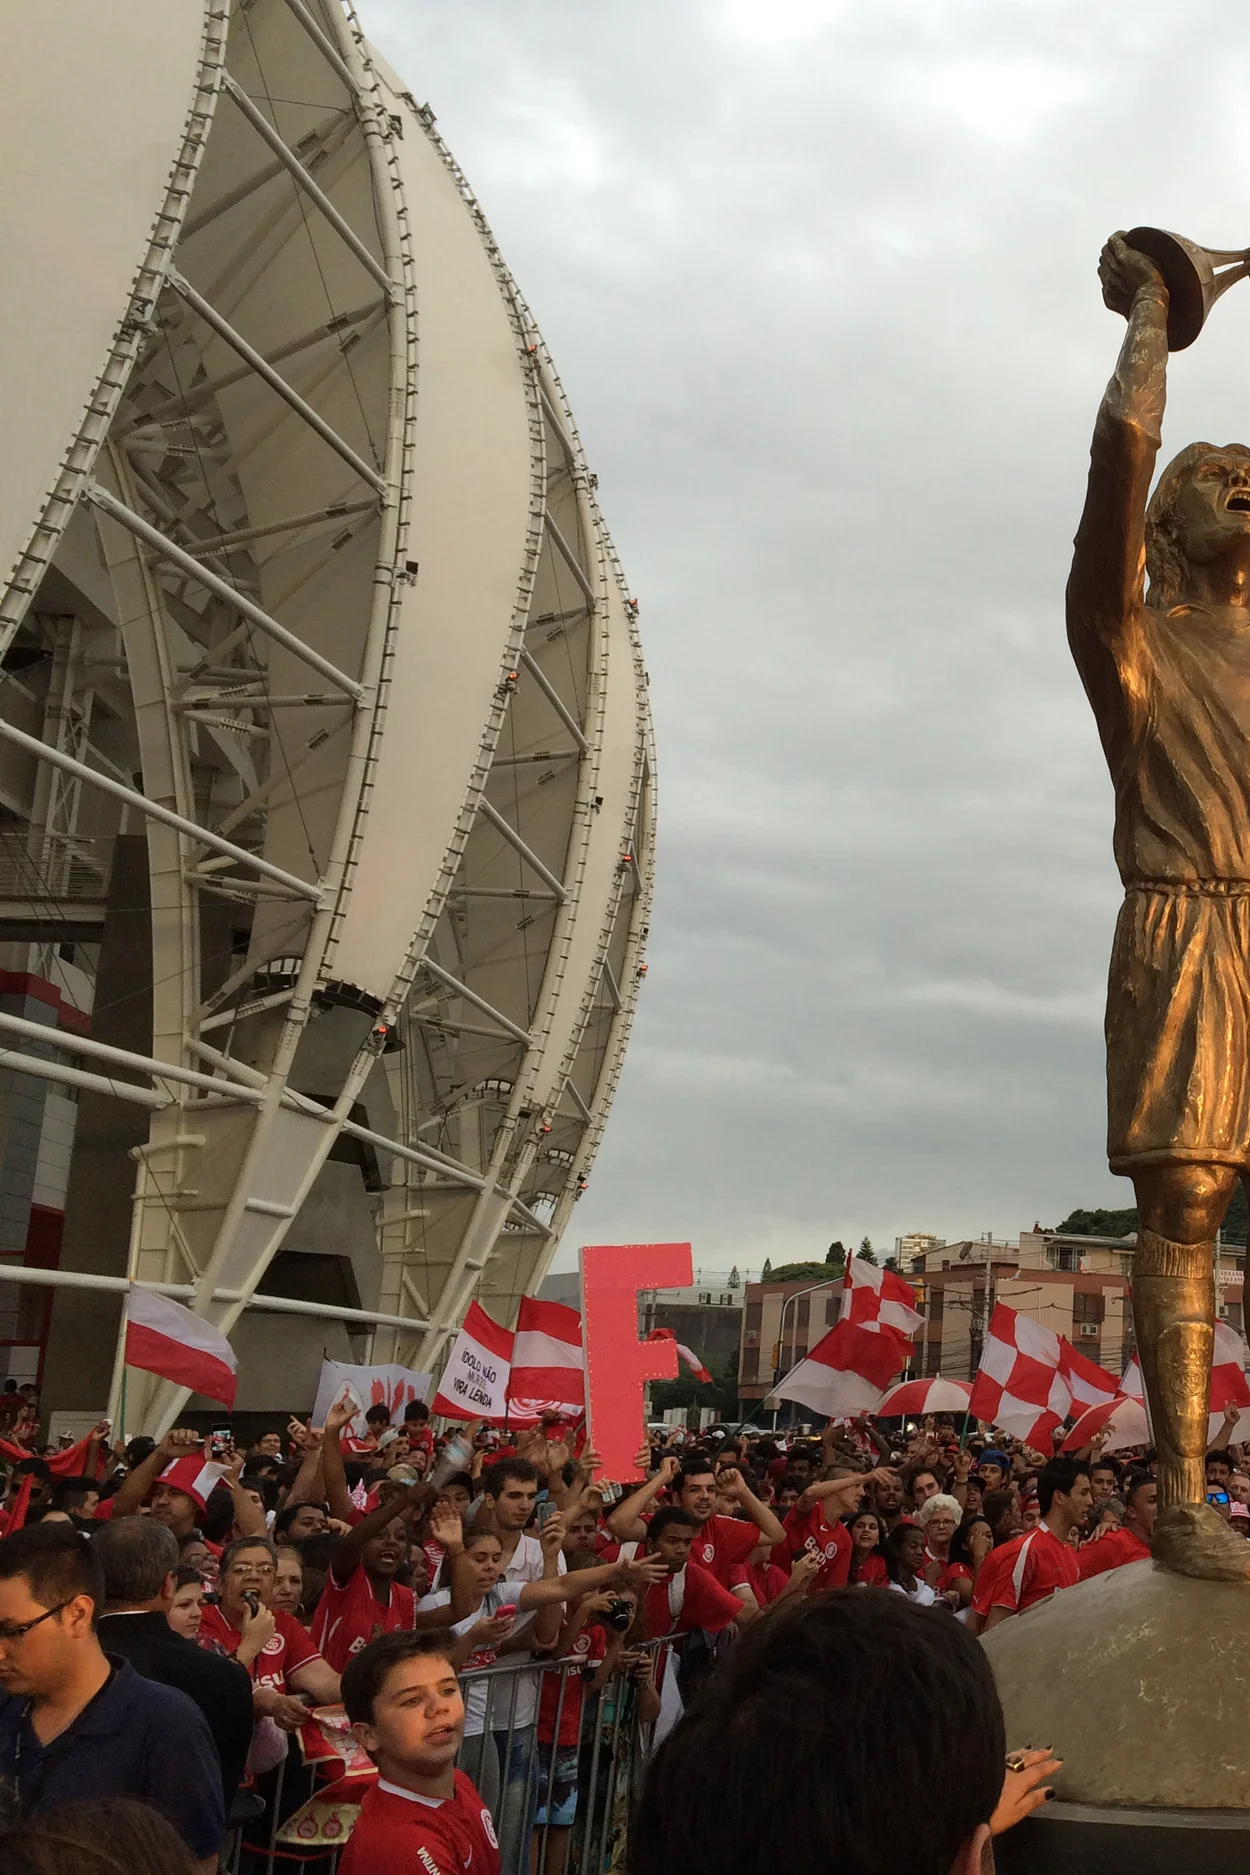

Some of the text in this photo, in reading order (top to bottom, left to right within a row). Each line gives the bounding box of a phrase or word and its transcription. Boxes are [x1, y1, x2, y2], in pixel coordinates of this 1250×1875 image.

[461, 1346, 497, 1384] ÍDOLO NÃO
[577, 1242, 694, 1484] F
[453, 1377, 492, 1409] VIRA LENDA
